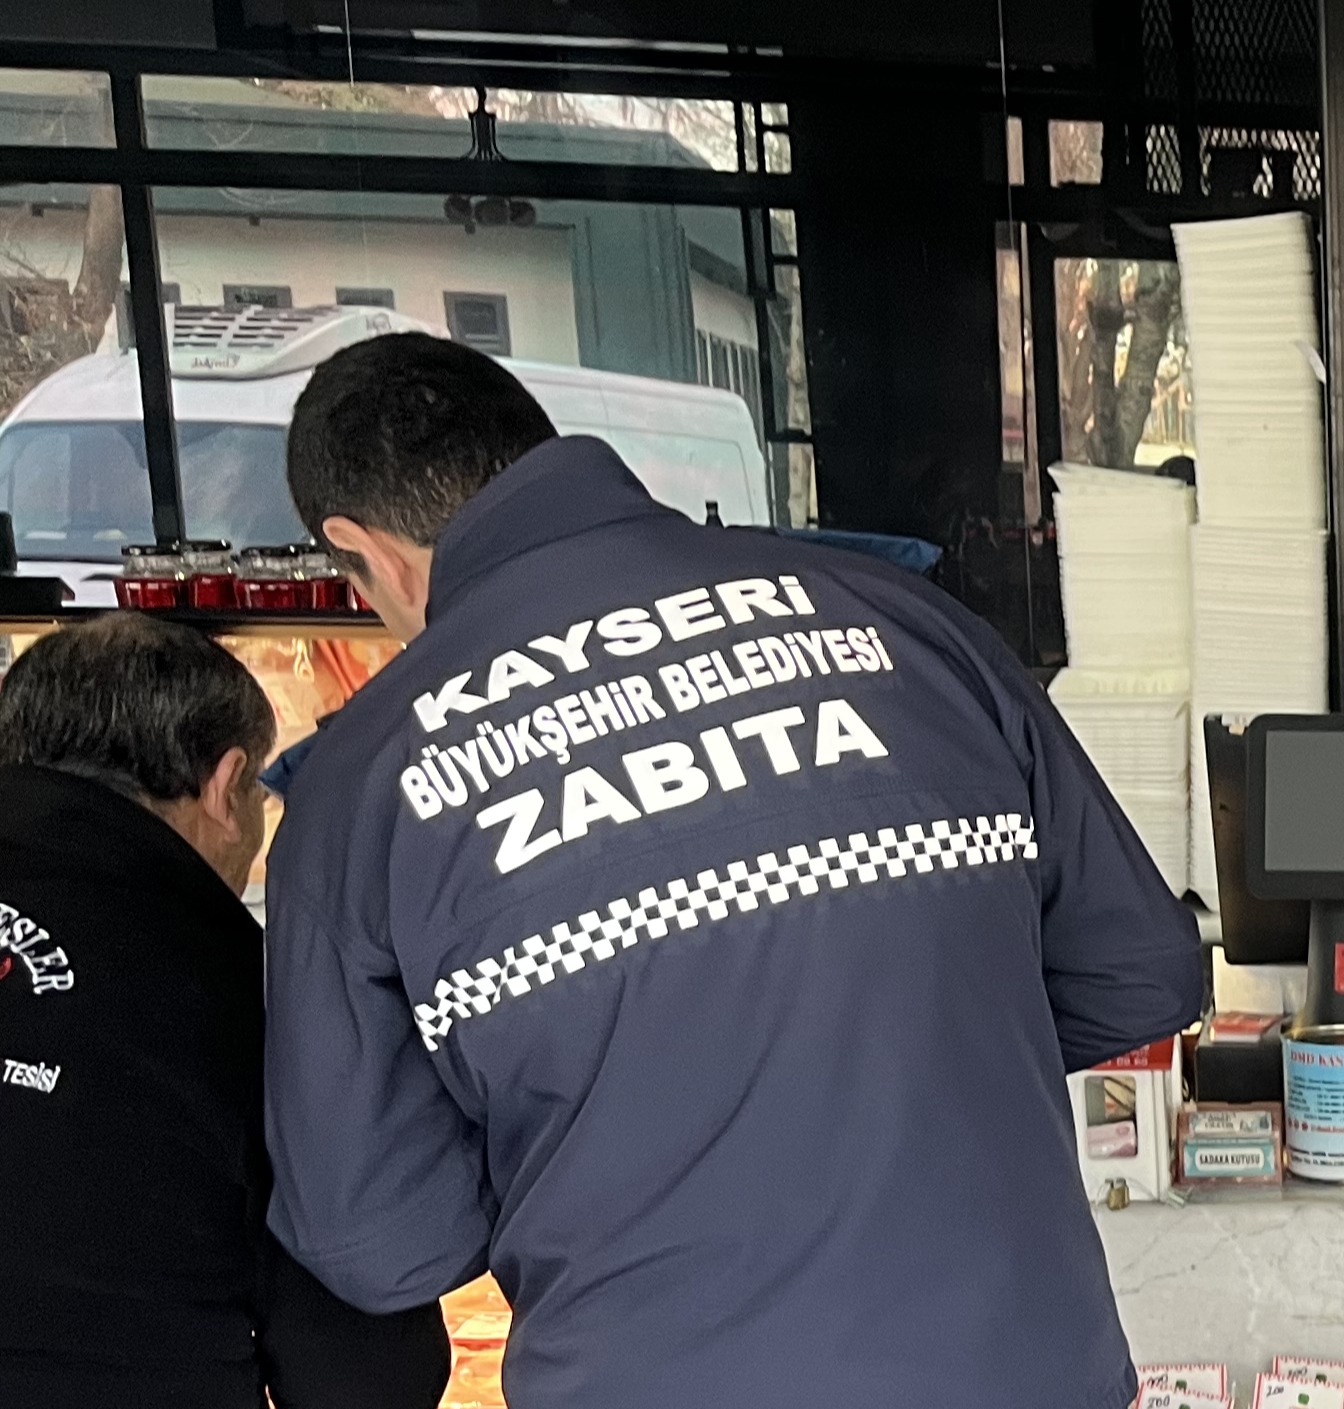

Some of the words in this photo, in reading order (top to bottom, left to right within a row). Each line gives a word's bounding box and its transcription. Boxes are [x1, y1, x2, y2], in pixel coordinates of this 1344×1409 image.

[400, 673, 667, 821] BÜYÜKŞEHİR
[658, 625, 895, 714] BELEDİYESİ
[413, 575, 816, 734] KAYSERİ
[475, 698, 889, 875] ZABITA
